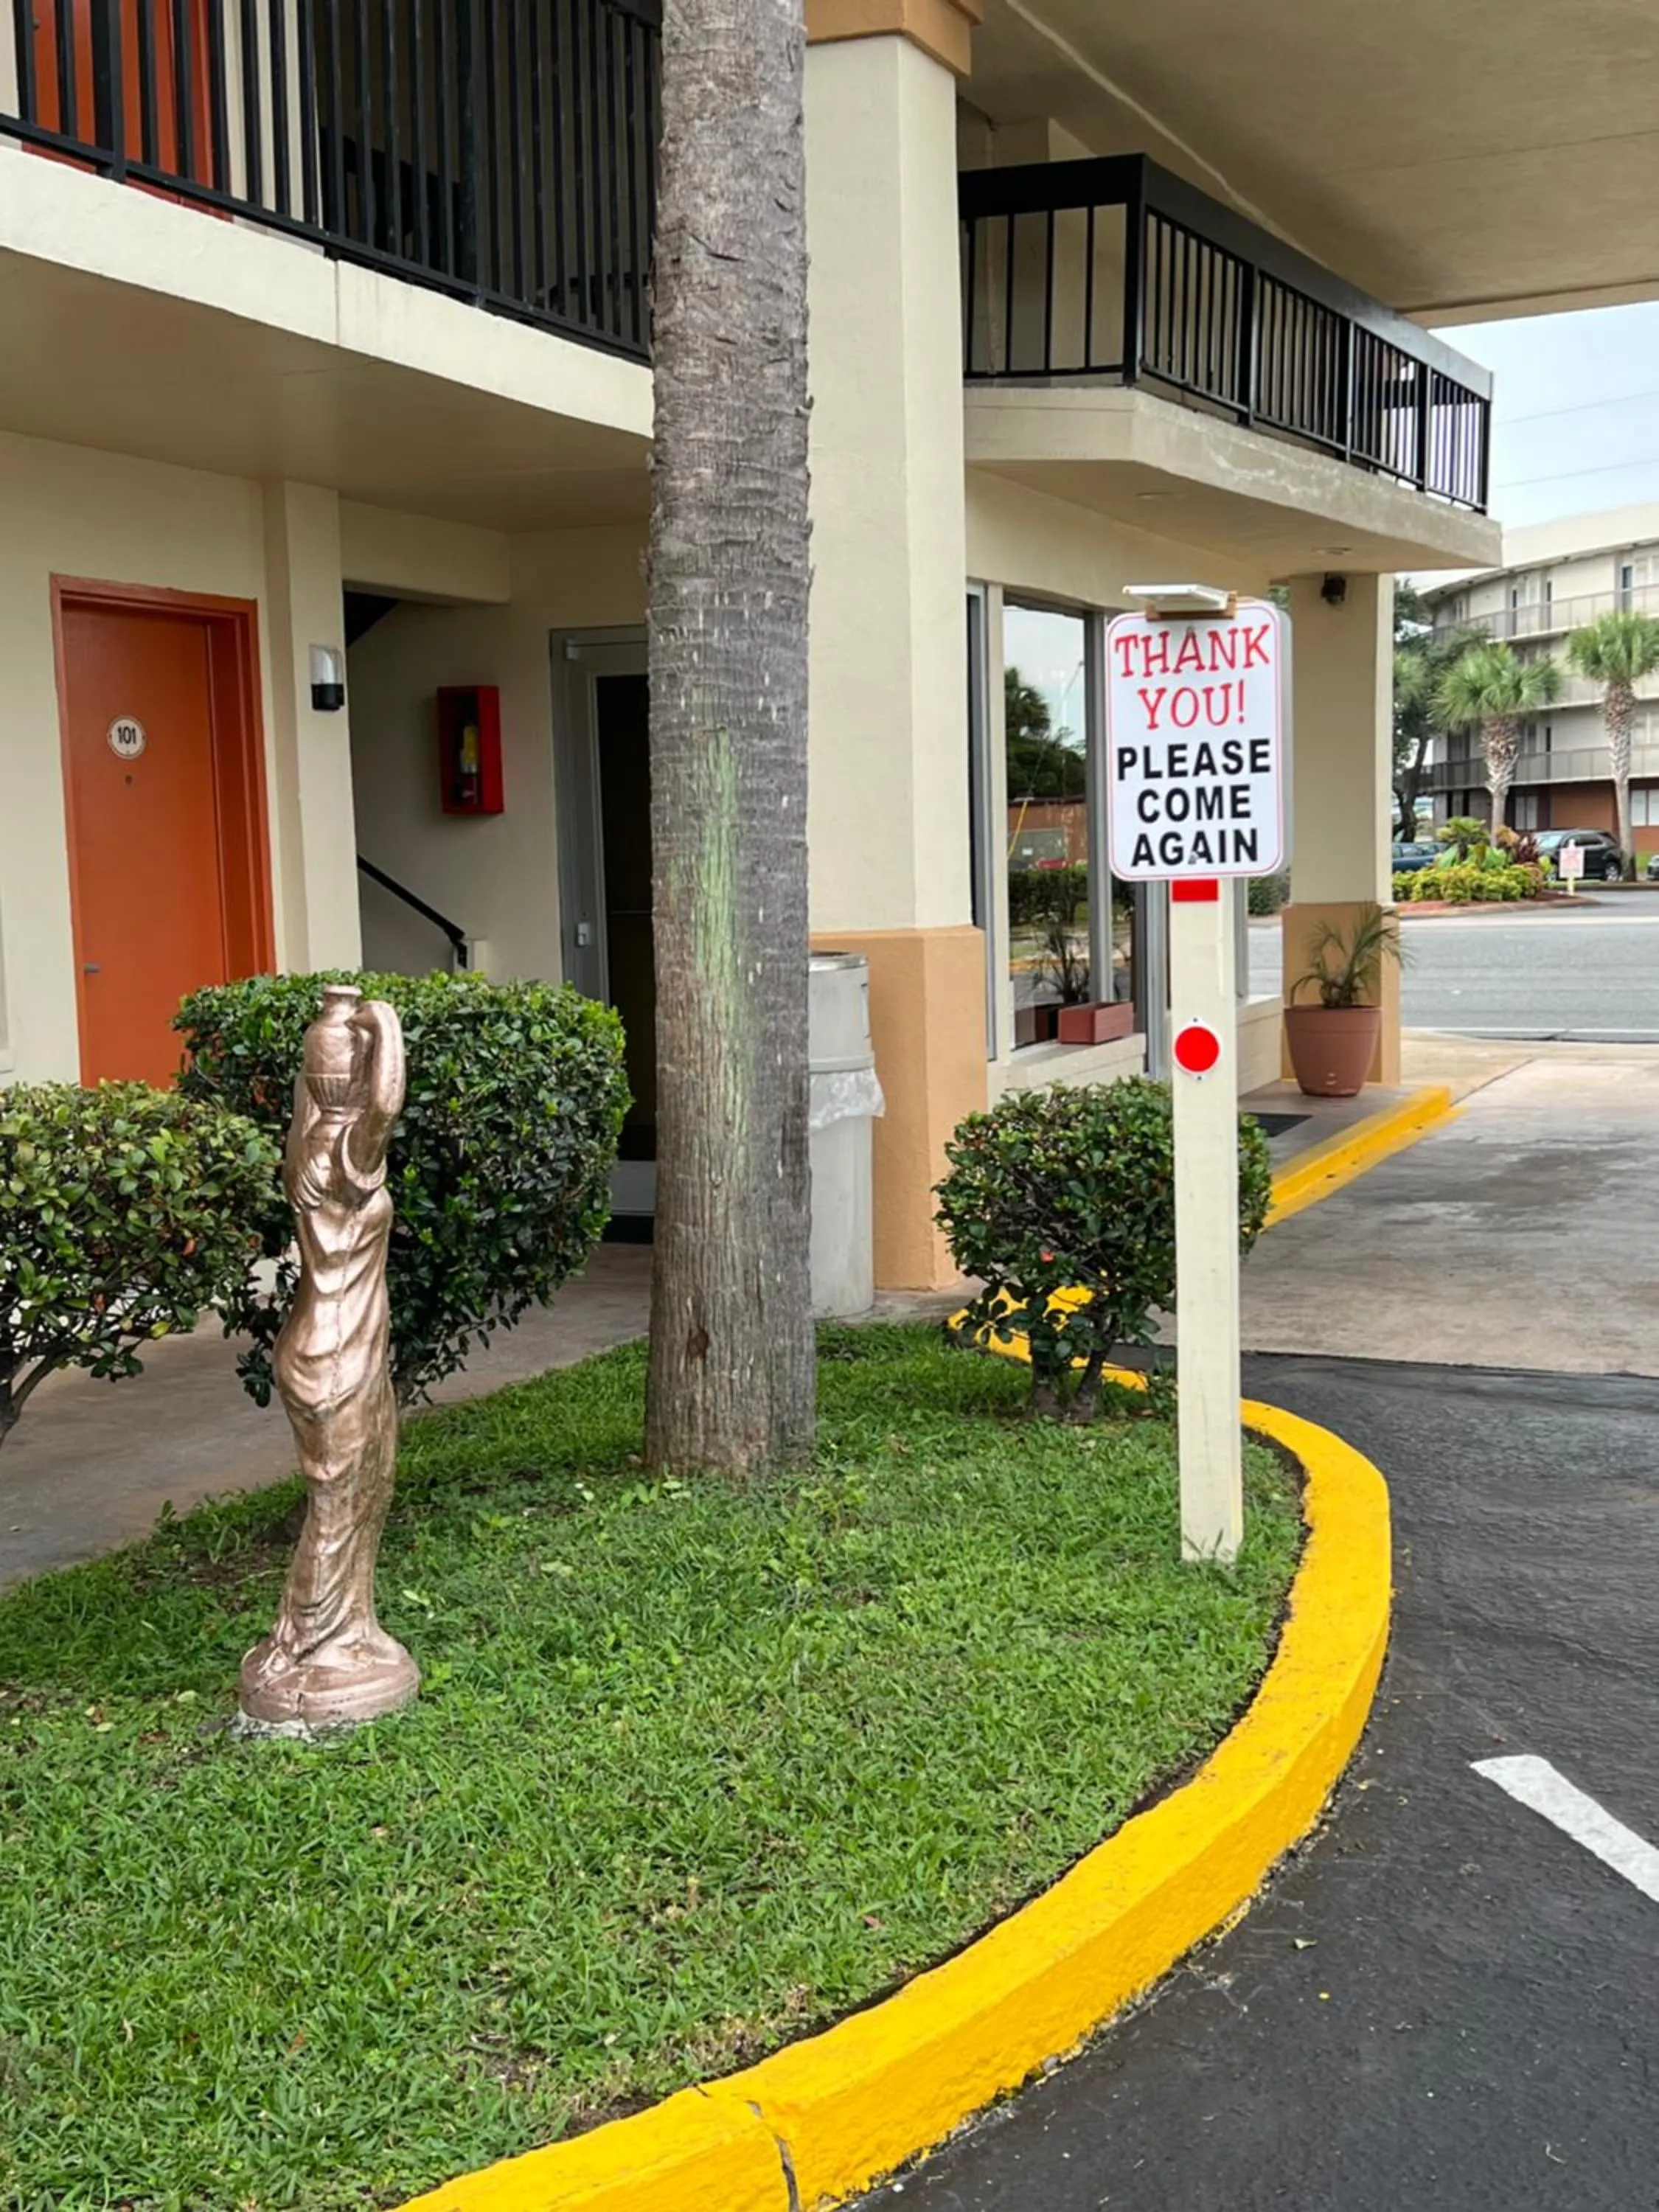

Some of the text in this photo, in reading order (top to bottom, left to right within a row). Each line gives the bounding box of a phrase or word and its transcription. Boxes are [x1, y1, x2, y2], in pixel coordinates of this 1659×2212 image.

[1115, 624, 1270, 677] THANK
[1138, 679, 1245, 730] YOU!
[117, 726, 136, 744] 101
[1117, 738, 1271, 781] PLEASE
[1137, 785, 1251, 824] COME
[1130, 828, 1258, 867] AGAIN
